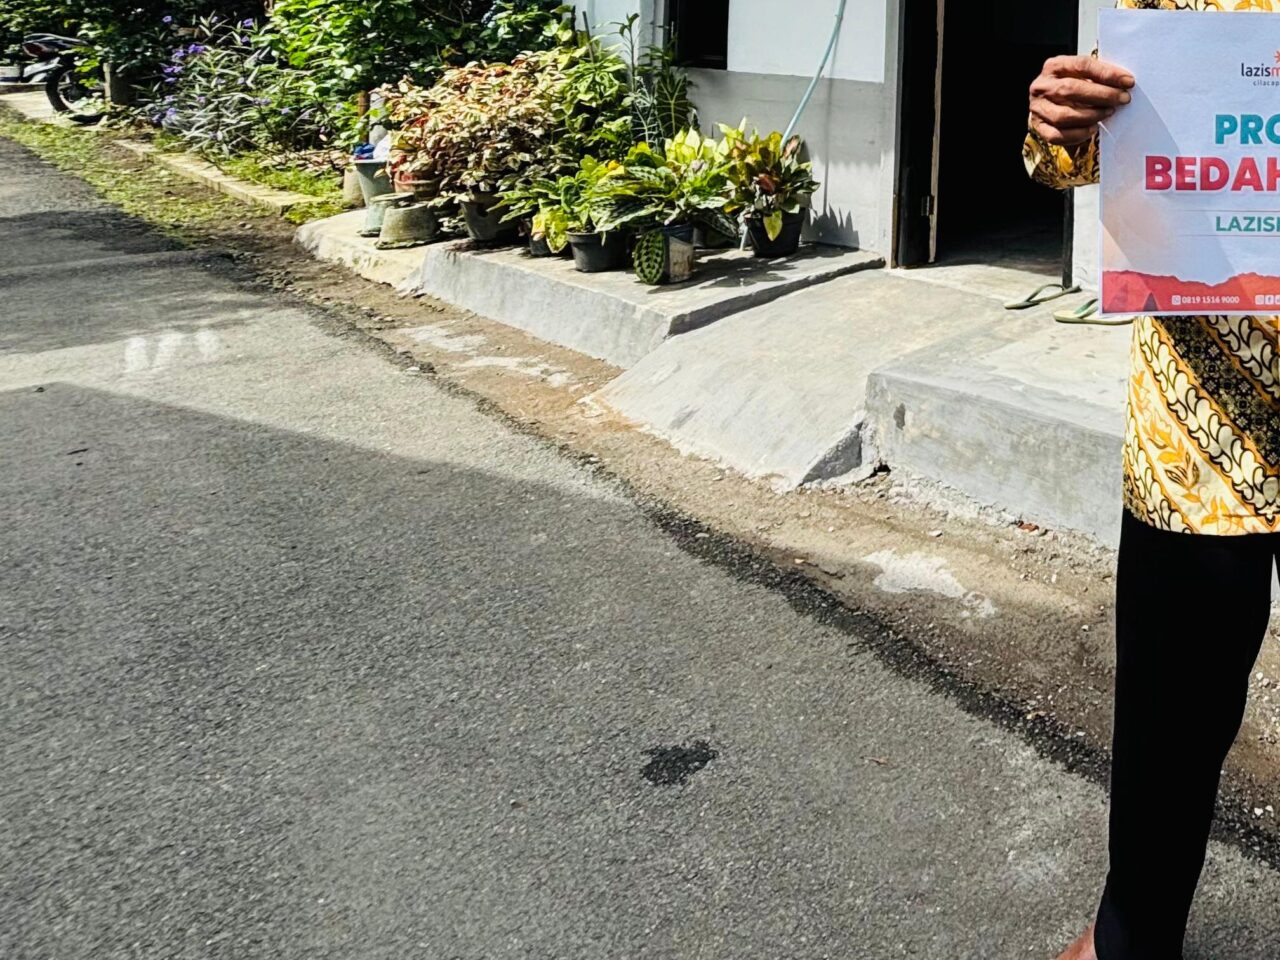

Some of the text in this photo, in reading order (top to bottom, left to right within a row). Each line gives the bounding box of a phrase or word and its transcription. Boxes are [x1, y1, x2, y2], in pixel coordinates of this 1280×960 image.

[1252, 80, 1280, 88] cilacap
[1181, 296, 1200, 304] 0819
[1222, 295, 1240, 304] 9000
